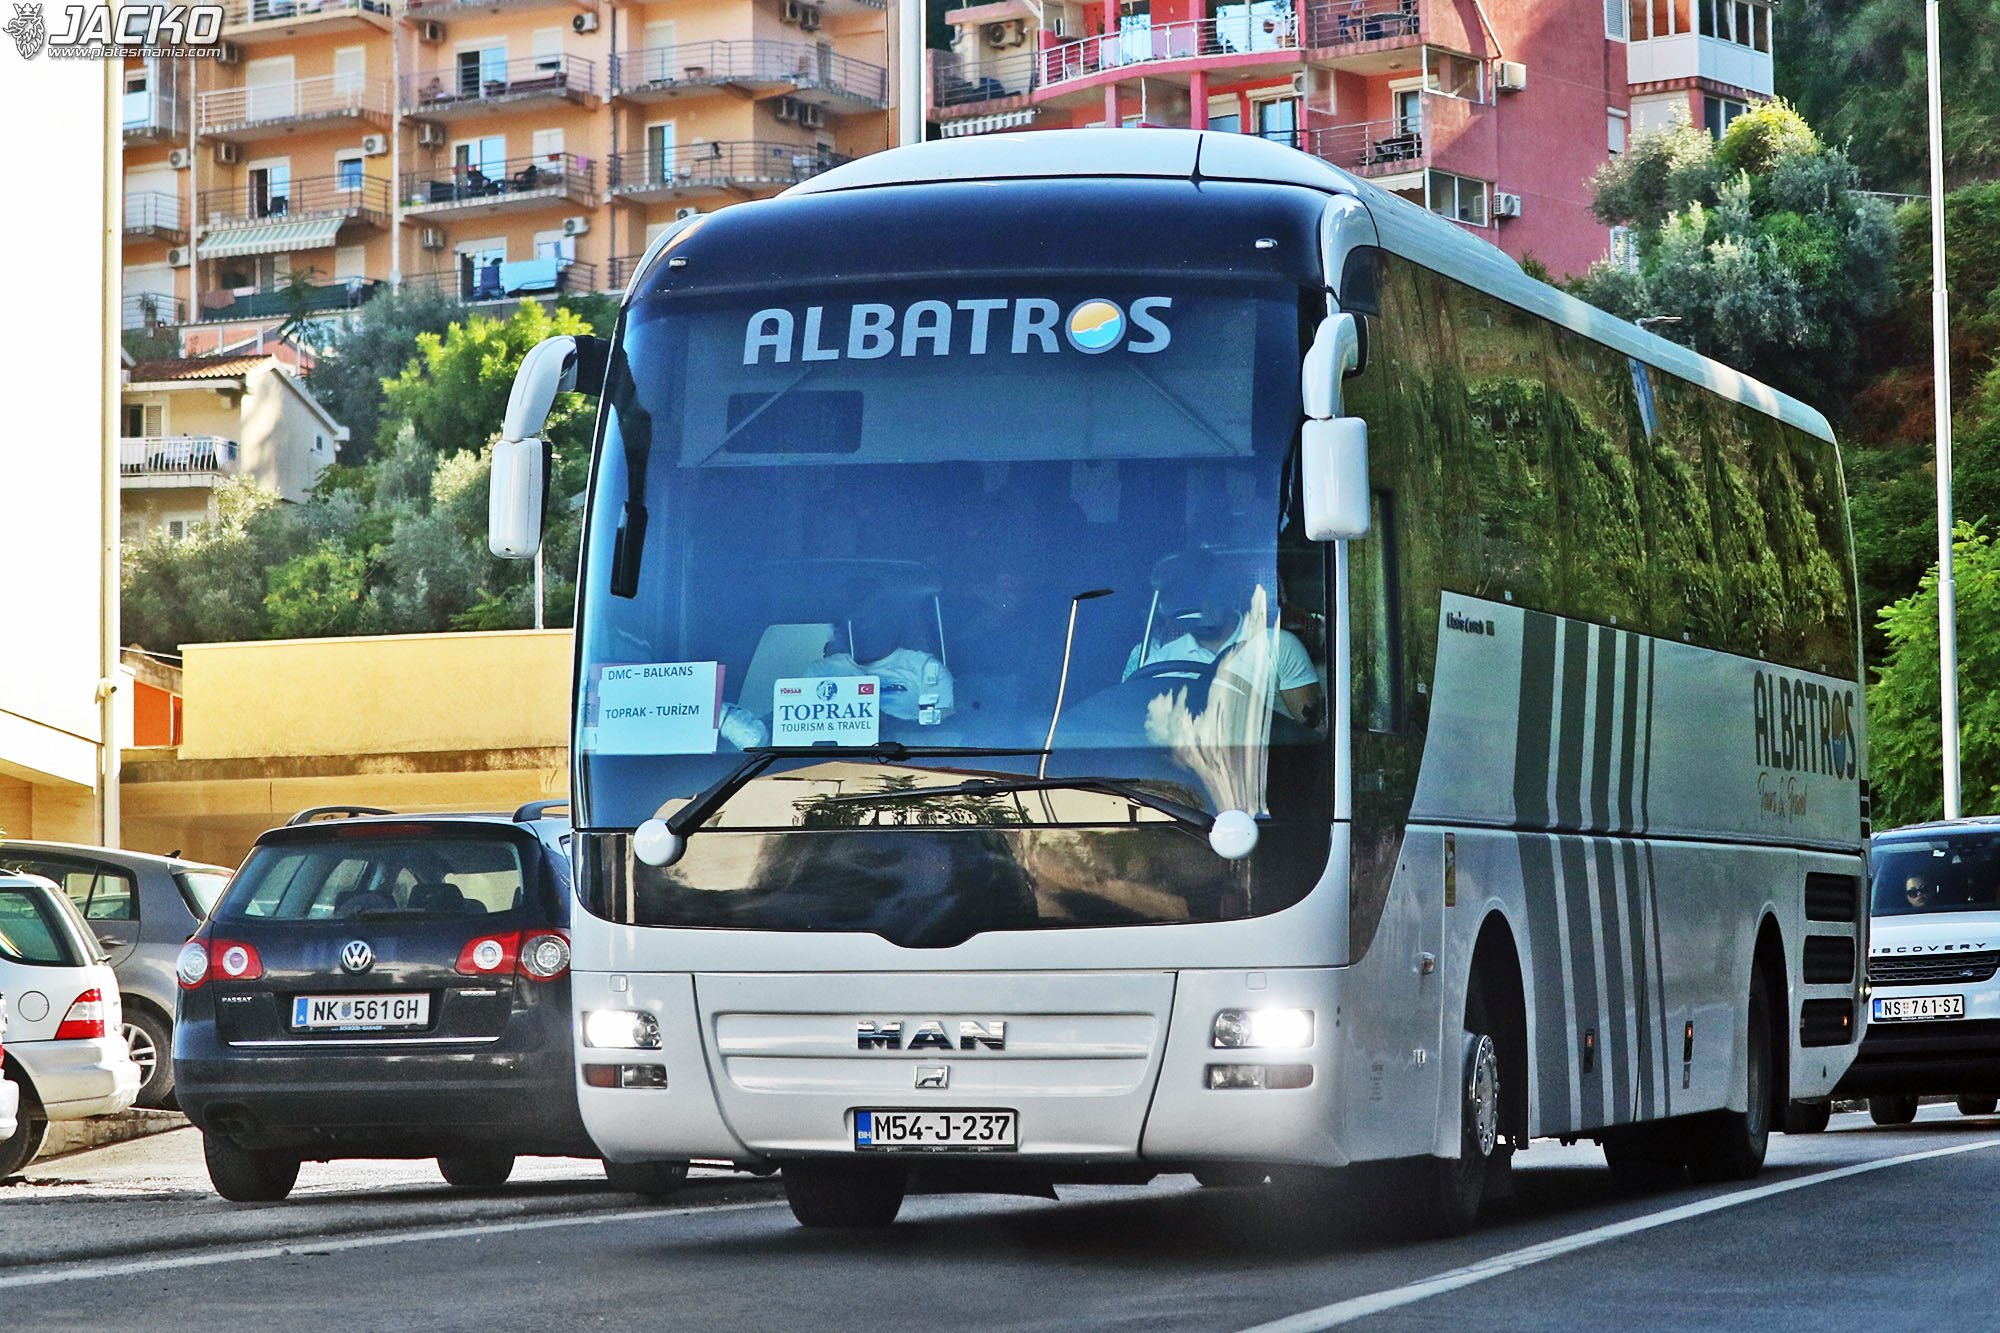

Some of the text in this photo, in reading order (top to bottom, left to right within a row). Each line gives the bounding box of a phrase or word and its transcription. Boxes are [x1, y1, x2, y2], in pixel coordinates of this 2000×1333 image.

[743, 296, 1172, 365] ALBATROS
[608, 669, 632, 680] DMC
[643, 666, 694, 678] BALKANS
[605, 706, 647, 719] TOPRAK
[656, 703, 700, 717] TURİZM
[780, 702, 873, 721] TOPRAK
[781, 720, 871, 733] TOURISM & TRAVEL
[1754, 670, 1857, 781] ALBATROS
[297, 1014, 305, 1022] A
[313, 1001, 339, 1021] NK
[1884, 1001, 1901, 1016] NS
[856, 1020, 1007, 1051] MAN
[874, 1115, 1010, 1141] M54-J-237
